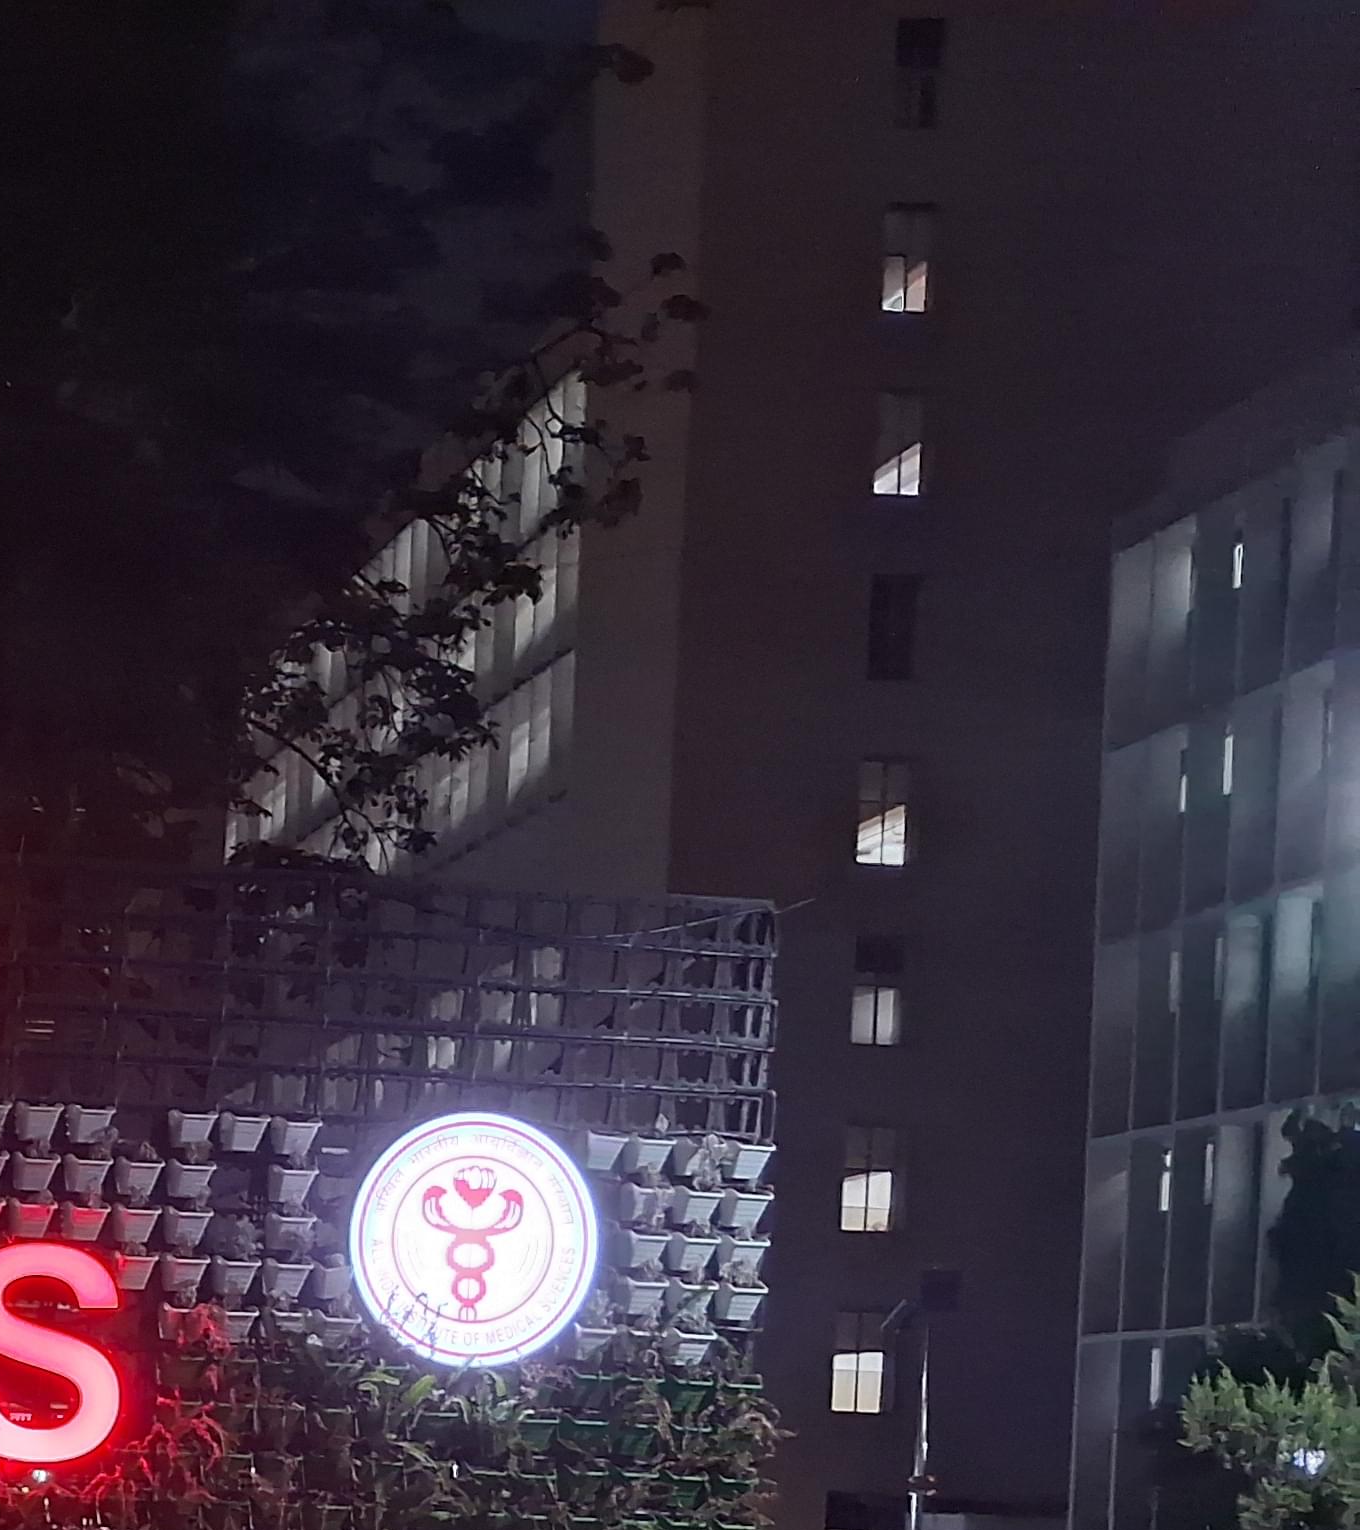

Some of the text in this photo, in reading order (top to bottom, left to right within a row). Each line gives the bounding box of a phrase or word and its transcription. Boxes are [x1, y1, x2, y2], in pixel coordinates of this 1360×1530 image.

[463, 1331, 480, 1346] OF
[485, 1315, 543, 1345] MEDICAL
[542, 1247, 576, 1312] SCIENCES
